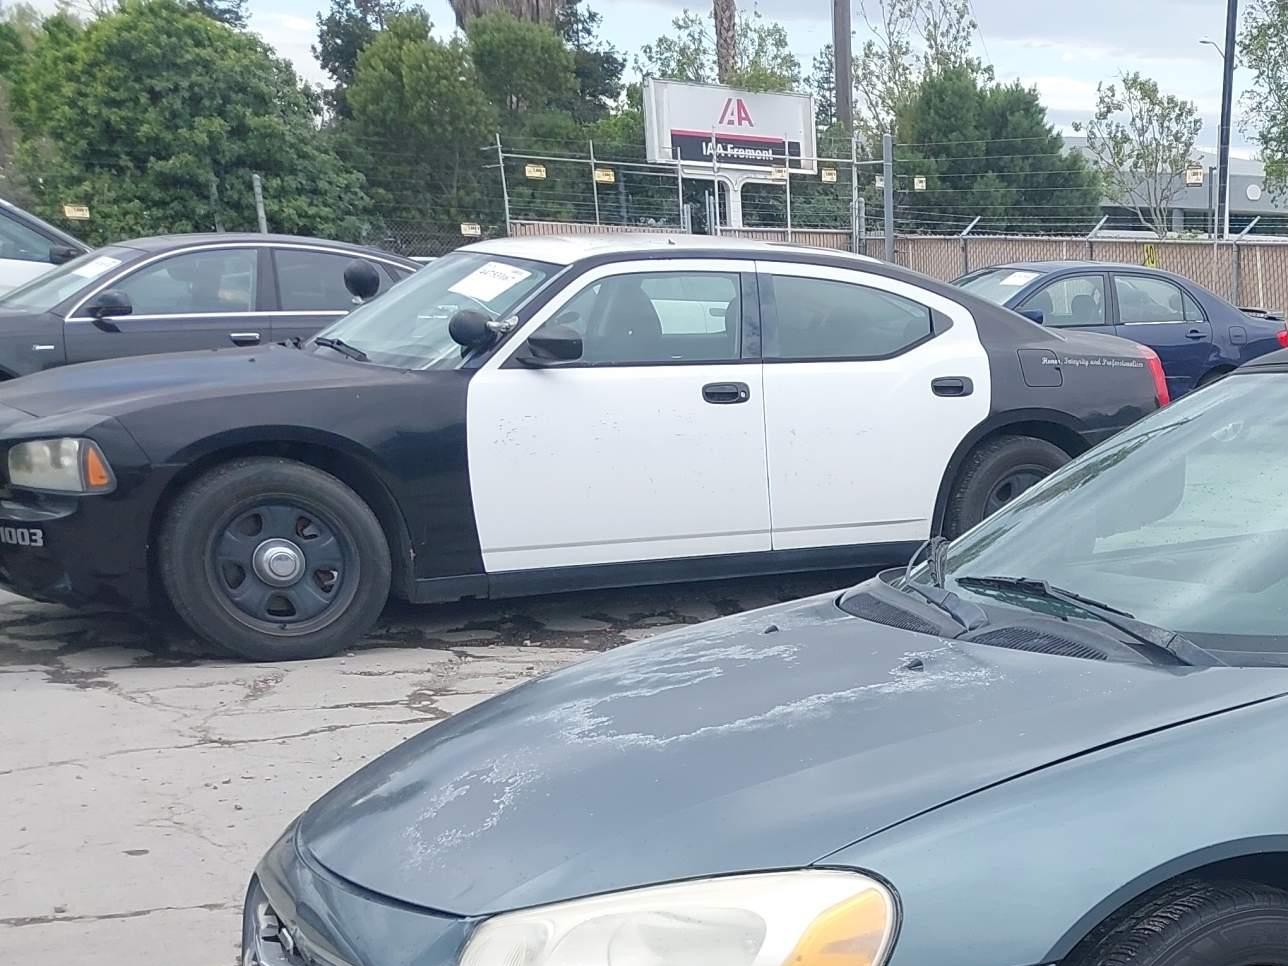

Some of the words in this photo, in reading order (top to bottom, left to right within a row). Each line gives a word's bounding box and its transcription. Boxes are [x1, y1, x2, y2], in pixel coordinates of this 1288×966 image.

[702, 141, 725, 157] IAA
[726, 144, 774, 160] Fremont
[1090, 357, 1102, 366] and
